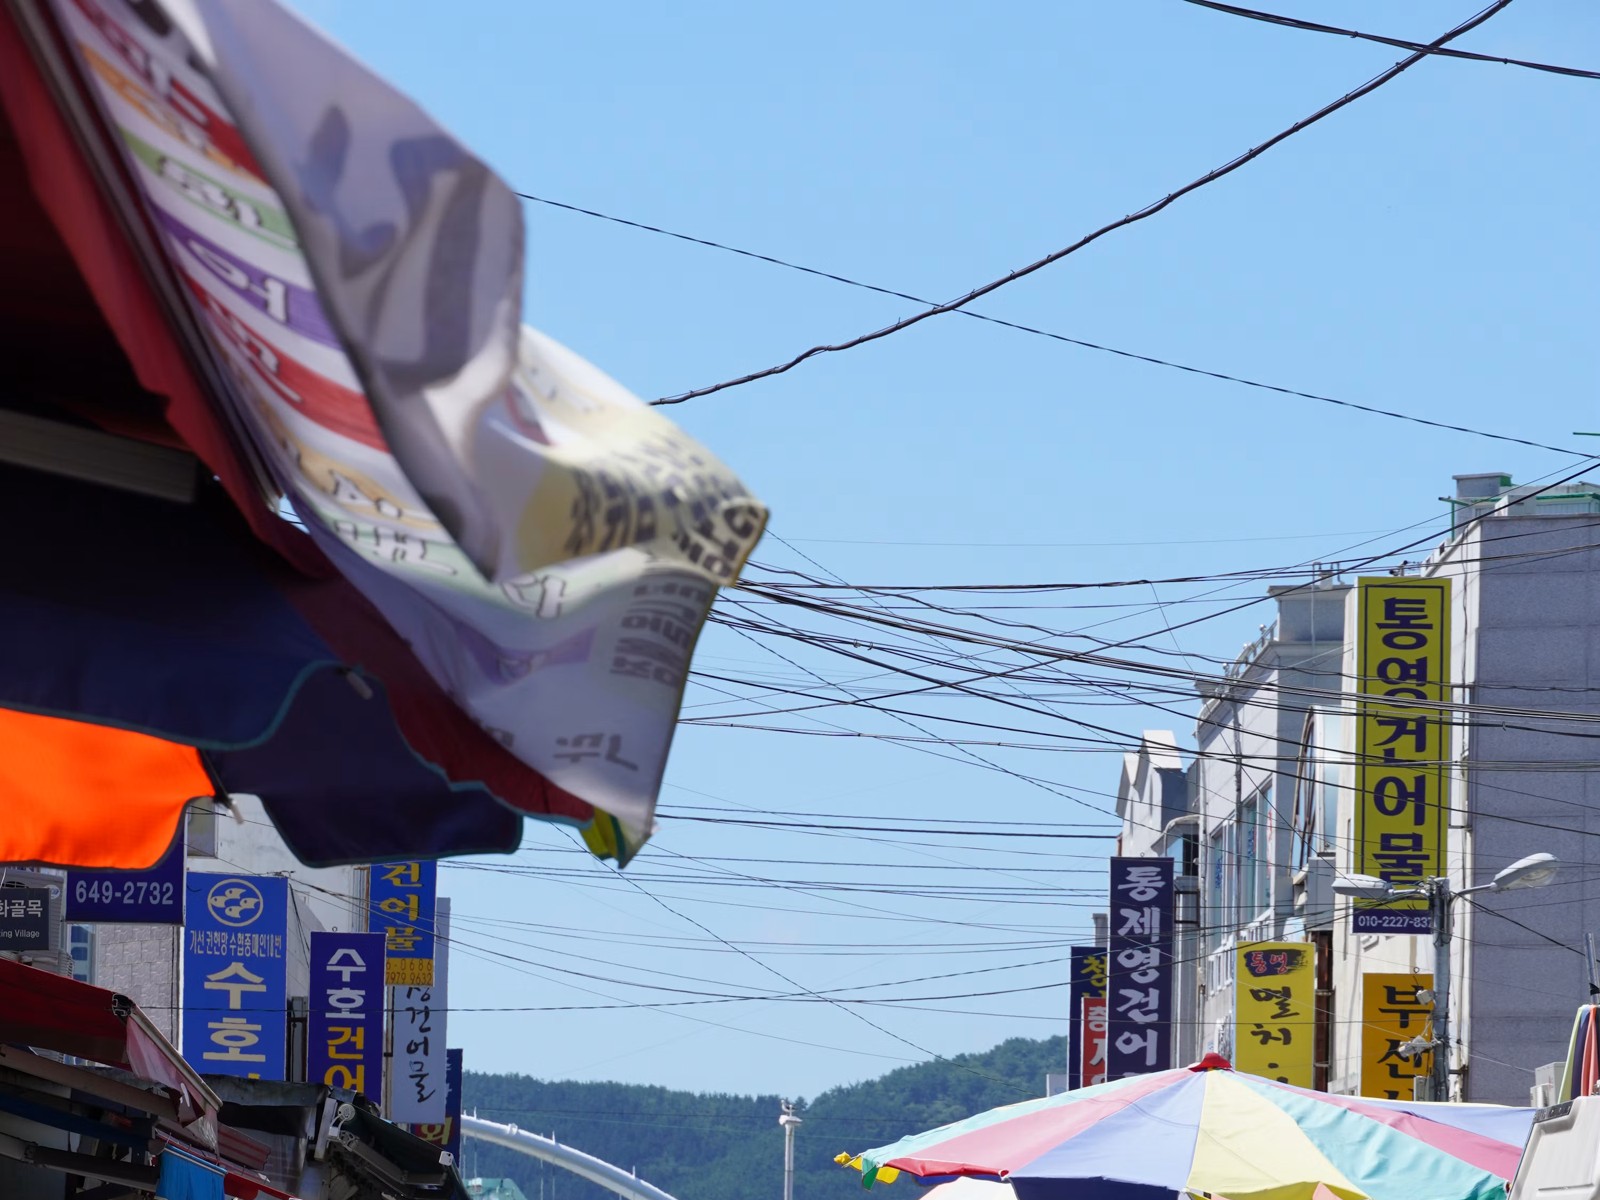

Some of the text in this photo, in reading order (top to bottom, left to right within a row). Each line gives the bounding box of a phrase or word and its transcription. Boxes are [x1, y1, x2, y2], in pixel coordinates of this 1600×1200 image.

[1372, 597, 1434, 893] 통영건어물
[75, 880, 174, 905] 649-2732
[1358, 916, 1432, 928] 010-2227-837
[14, 929, 40, 939] Village
[1115, 866, 1166, 1080] 통제영건어
[203, 962, 266, 1062] 수호
[1250, 986, 1300, 1045] 멸치
[1378, 985, 1432, 1100] 부산
